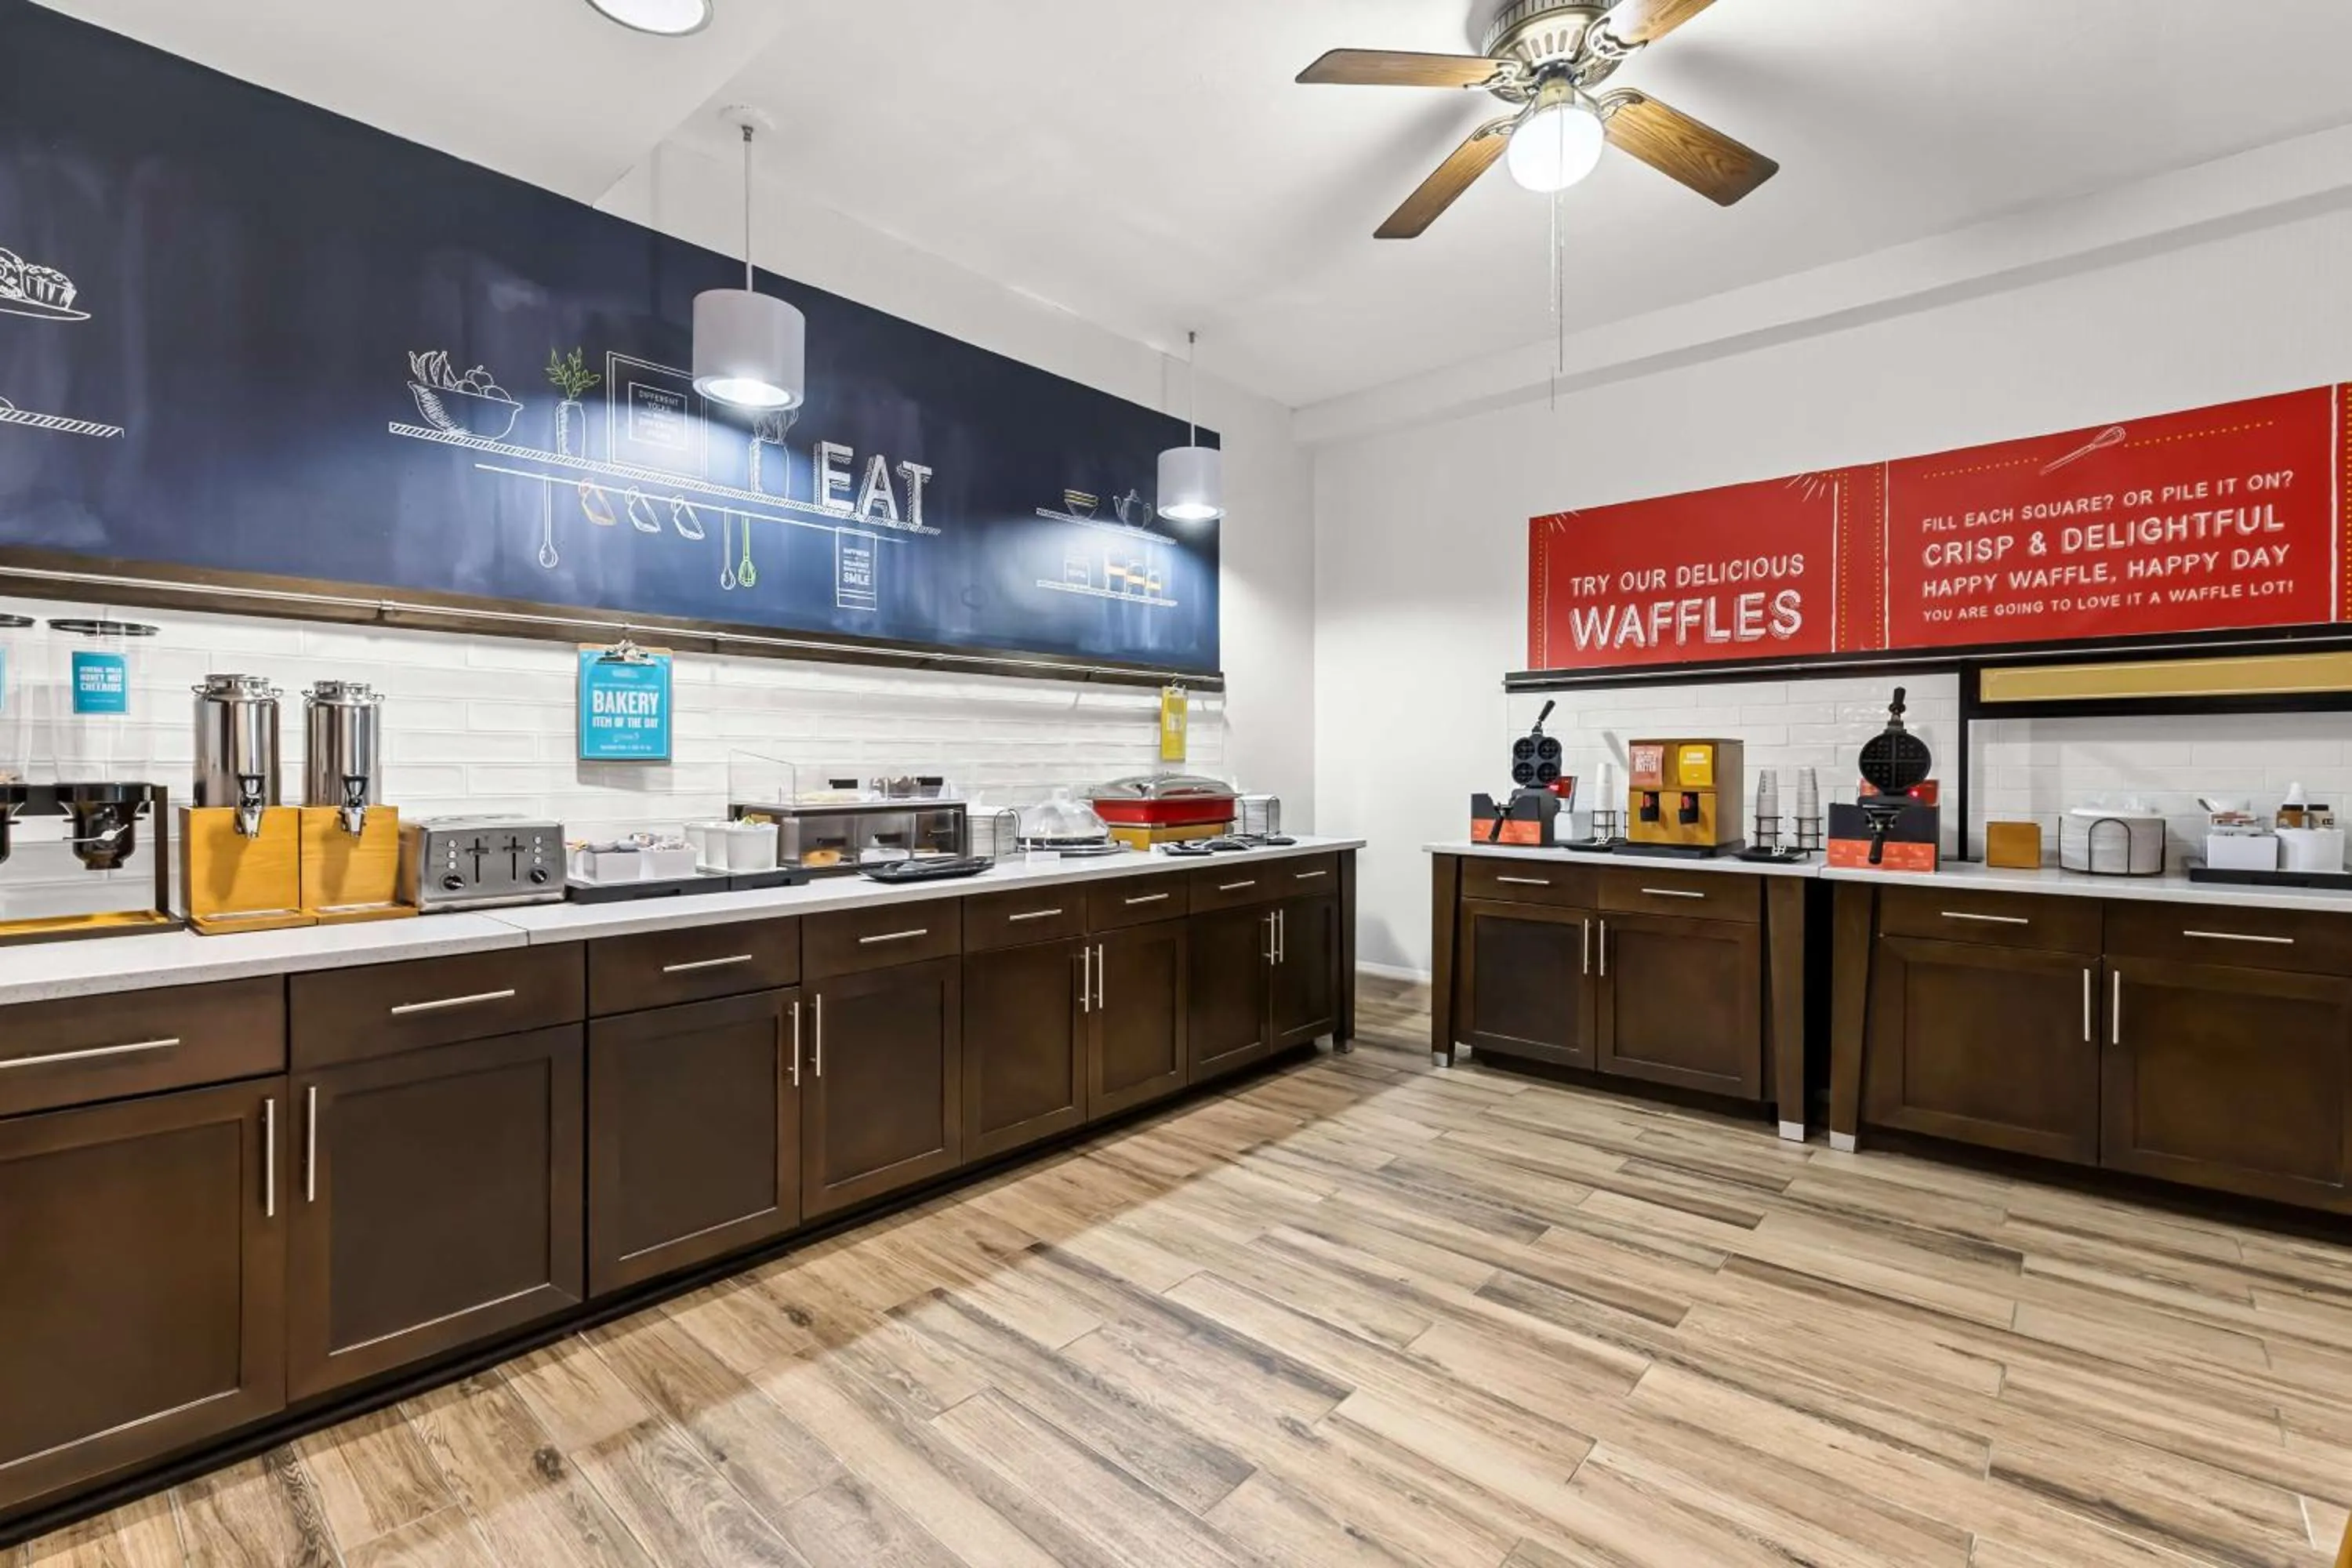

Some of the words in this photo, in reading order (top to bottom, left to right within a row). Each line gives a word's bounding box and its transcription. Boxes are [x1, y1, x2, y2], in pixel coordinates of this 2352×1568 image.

[814, 441, 932, 526] EAT
[1922, 516, 1957, 533] FILL
[1964, 508, 2014, 528] EACH
[2022, 494, 2114, 520] SQUARE?
[2123, 490, 2153, 506] OR
[2161, 481, 2209, 503] PILE
[2217, 477, 2238, 496] IT
[2247, 470, 2294, 492] ON?
[1923, 535, 2014, 568] CRISP
[2027, 531, 2047, 556] &
[2062, 504, 2285, 554] DELIGHTFUL
[1570, 574, 1610, 597] TRY
[1620, 568, 1666, 593] OUR
[1675, 554, 1804, 589] DELICIOUS
[1922, 573, 1998, 598] HAPPY
[2009, 562, 2117, 590] WAFFLE,
[2127, 552, 2220, 579] HAPPY
[2230, 544, 2290, 571] DAY
[1569, 590, 1803, 652] WAFFLES
[1923, 609, 1953, 622] YOU
[1958, 605, 1988, 620] ARE
[1994, 601, 2044, 616] GOING
[2051, 599, 2071, 612] TO
[2078, 593, 2121, 611] LOVE
[2127, 592, 2143, 606] IT
[2148, 592, 2161, 604] A
[2169, 584, 2242, 603] WAFFLE
[2249, 580, 2293, 597] LOT!
[592, 689, 659, 715] BAKERY
[592, 715, 612, 728] ITEM
[614, 716, 625, 728] OF
[627, 717, 642, 728] THE
[644, 717, 659, 728] DAY
